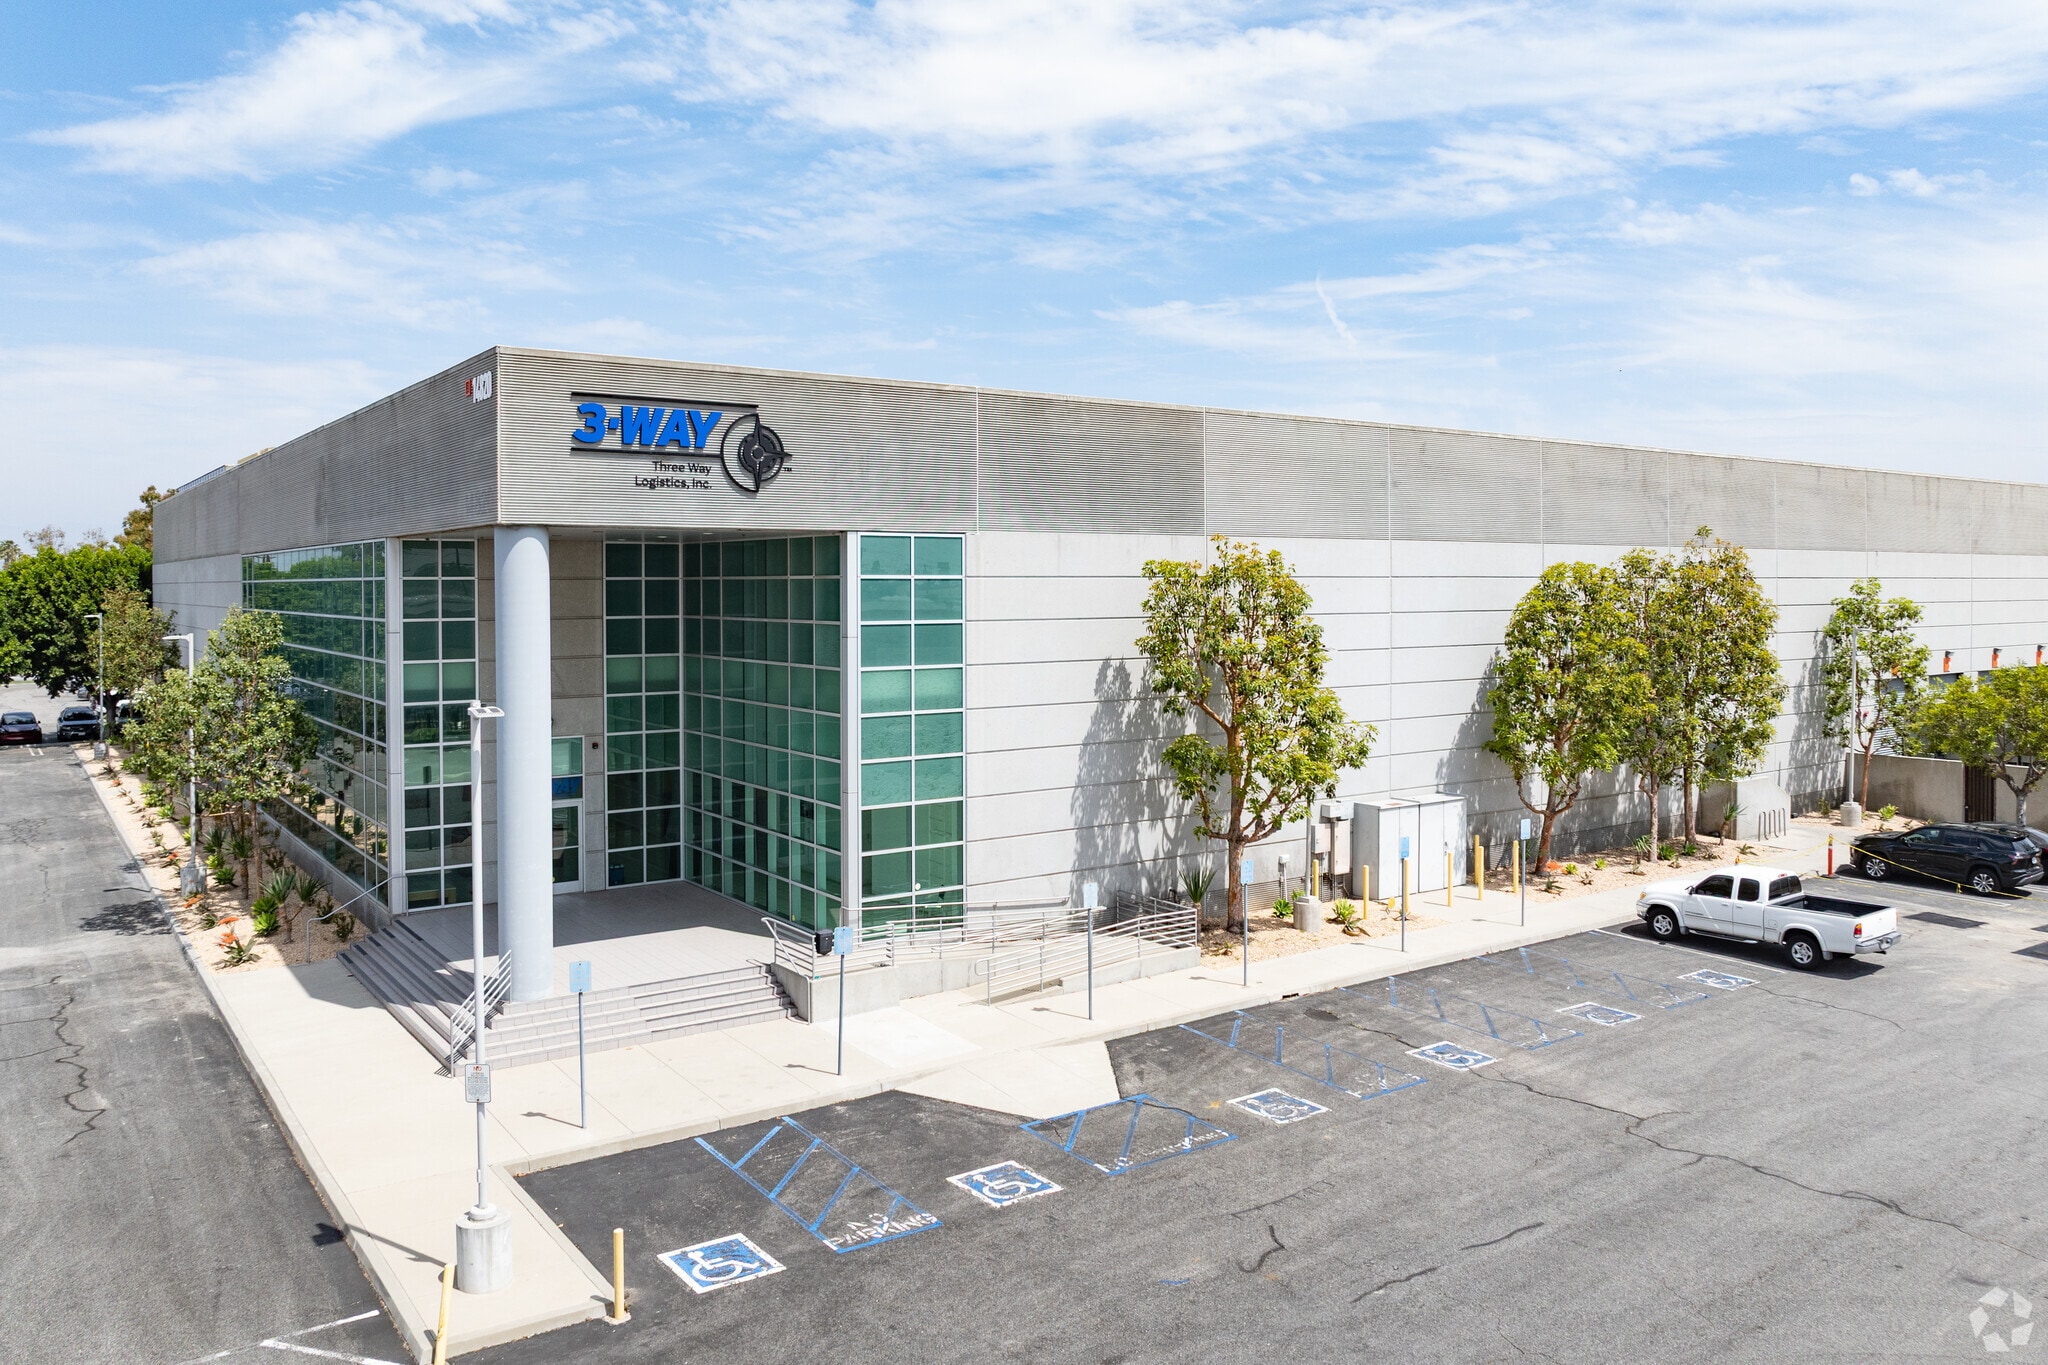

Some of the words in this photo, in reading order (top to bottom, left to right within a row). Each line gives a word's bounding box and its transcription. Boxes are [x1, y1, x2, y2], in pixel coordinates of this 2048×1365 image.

[572, 402, 723, 448] 3-WAY
[652, 460, 686, 473] Three
[688, 462, 712, 476] Way
[635, 475, 690, 489] Logistics,
[692, 477, 712, 489] Inc.
[823, 1212, 938, 1250] PARKING
